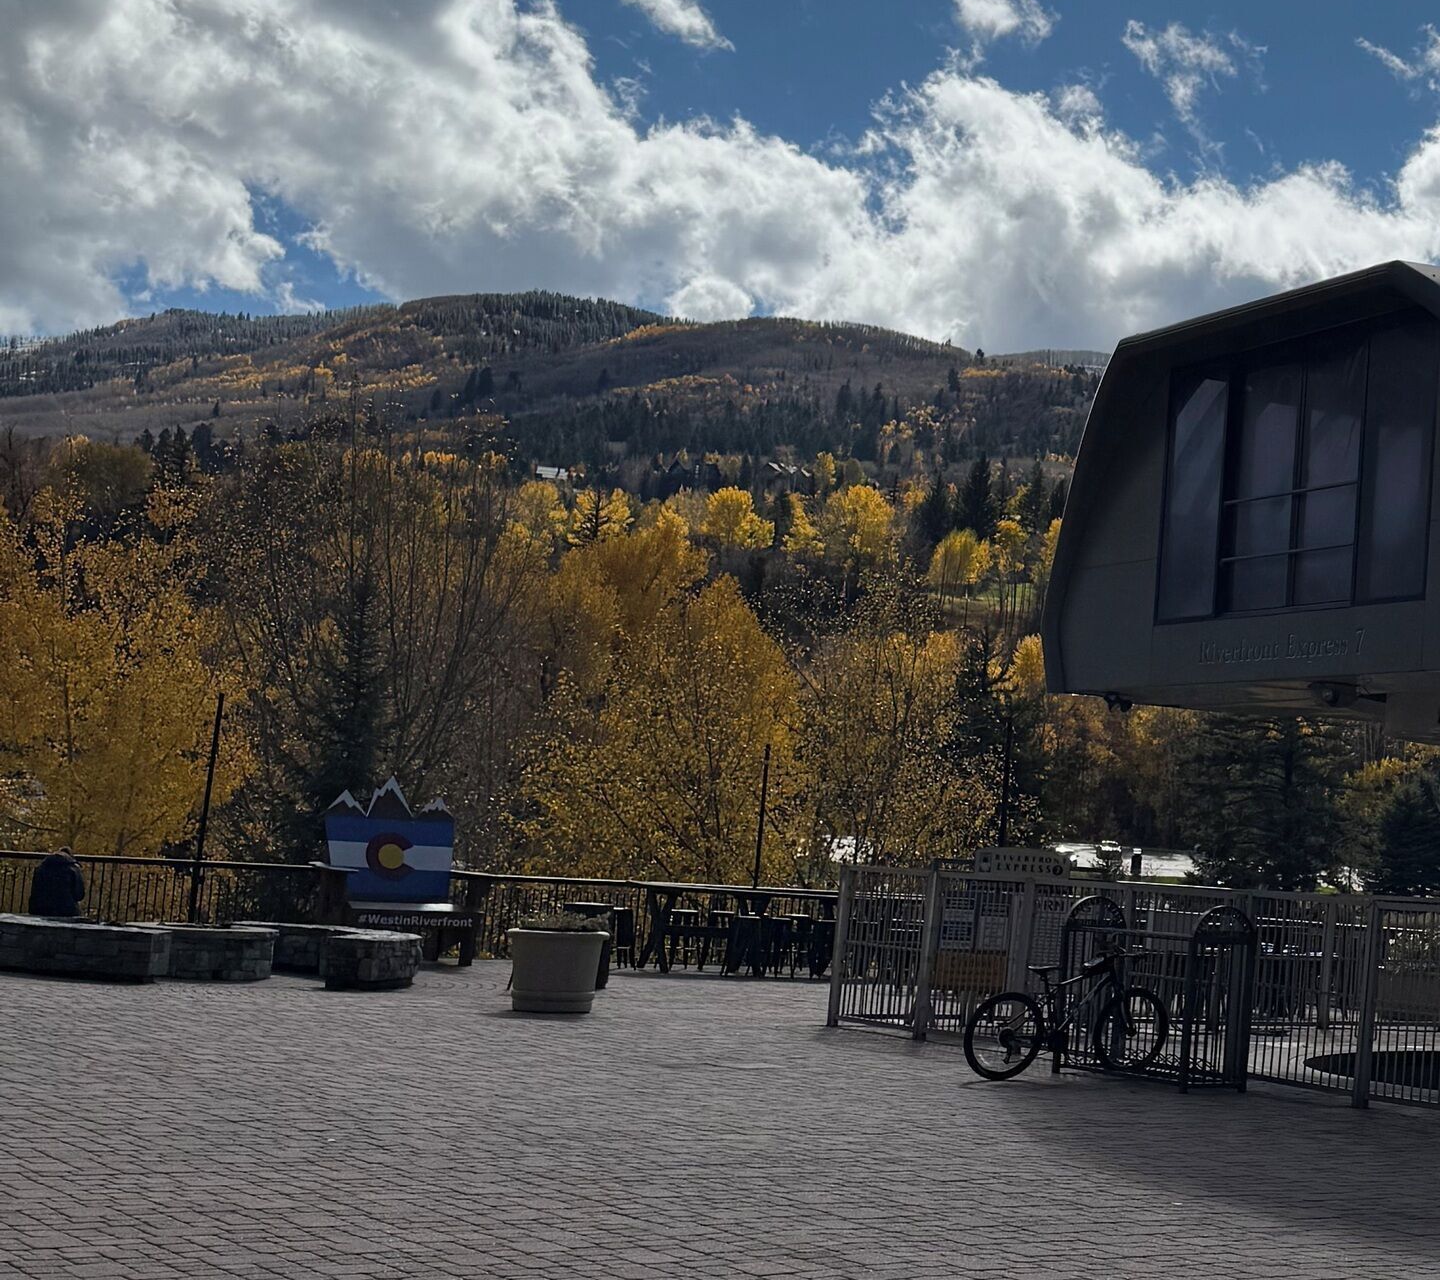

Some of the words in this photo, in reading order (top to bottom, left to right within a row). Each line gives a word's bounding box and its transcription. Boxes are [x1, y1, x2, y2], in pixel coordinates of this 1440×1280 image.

[1198, 638, 1279, 665] Riverfront
[1286, 632, 1349, 664] Express
[1354, 627, 1367, 656] 7
[995, 854, 1067, 865] RIVERFRONT
[996, 863, 1051, 874] EXPRESS
[358, 913, 473, 928] #WestinRiverfront
